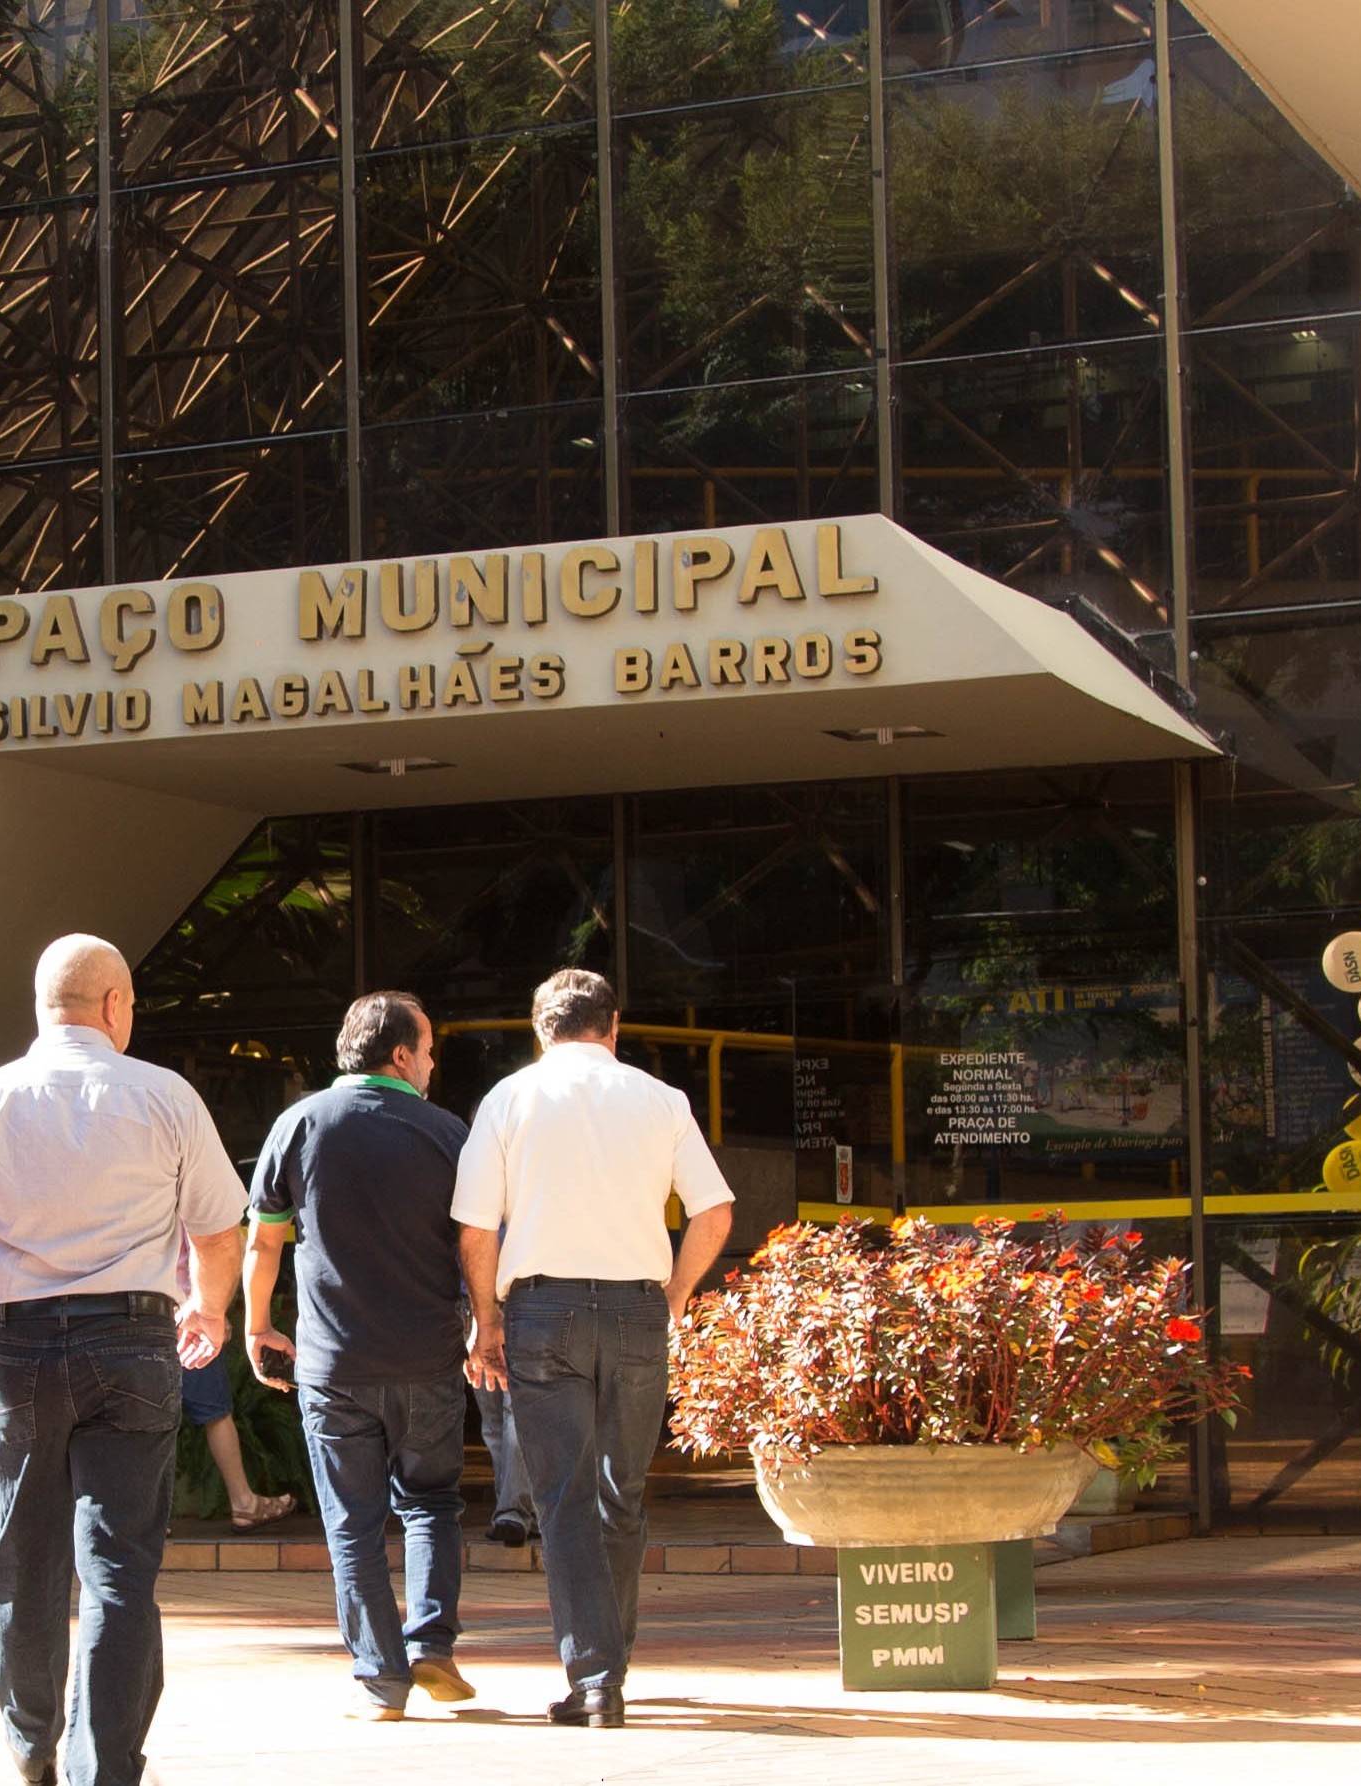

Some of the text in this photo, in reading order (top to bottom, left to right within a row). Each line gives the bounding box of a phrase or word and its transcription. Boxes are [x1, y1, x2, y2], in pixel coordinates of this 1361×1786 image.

[297, 523, 879, 642] MUNICIPAL
[182, 640, 567, 725] MAGALHÃES
[615, 629, 884, 694] BARROS
[1007, 985, 1064, 1014] ATI
[940, 1052, 1025, 1066] EXPEDIENTE
[952, 1068, 1013, 1081] NORMAL
[995, 1082, 1022, 1091] Sexta
[930, 1094, 948, 1103] das
[950, 1094, 976, 1103] 08:00
[992, 1093, 1018, 1102] 11:30
[1020, 1093, 1034, 1102] hs.
[926, 1107, 933, 1115] e
[934, 1106, 952, 1115] das
[955, 1105, 981, 1114] 13:30
[997, 1104, 1022, 1113] 17:00
[1024, 1104, 1038, 1113] hs.
[948, 1116, 1016, 1130] PRAÇA DE
[934, 1131, 1031, 1144] ATENDIMENTO
[1094, 1138, 1106, 1149] de
[859, 1561, 954, 1586] VIVEIRO
[854, 1601, 969, 1625] SEMUSP
[871, 1645, 945, 1668] PMM
